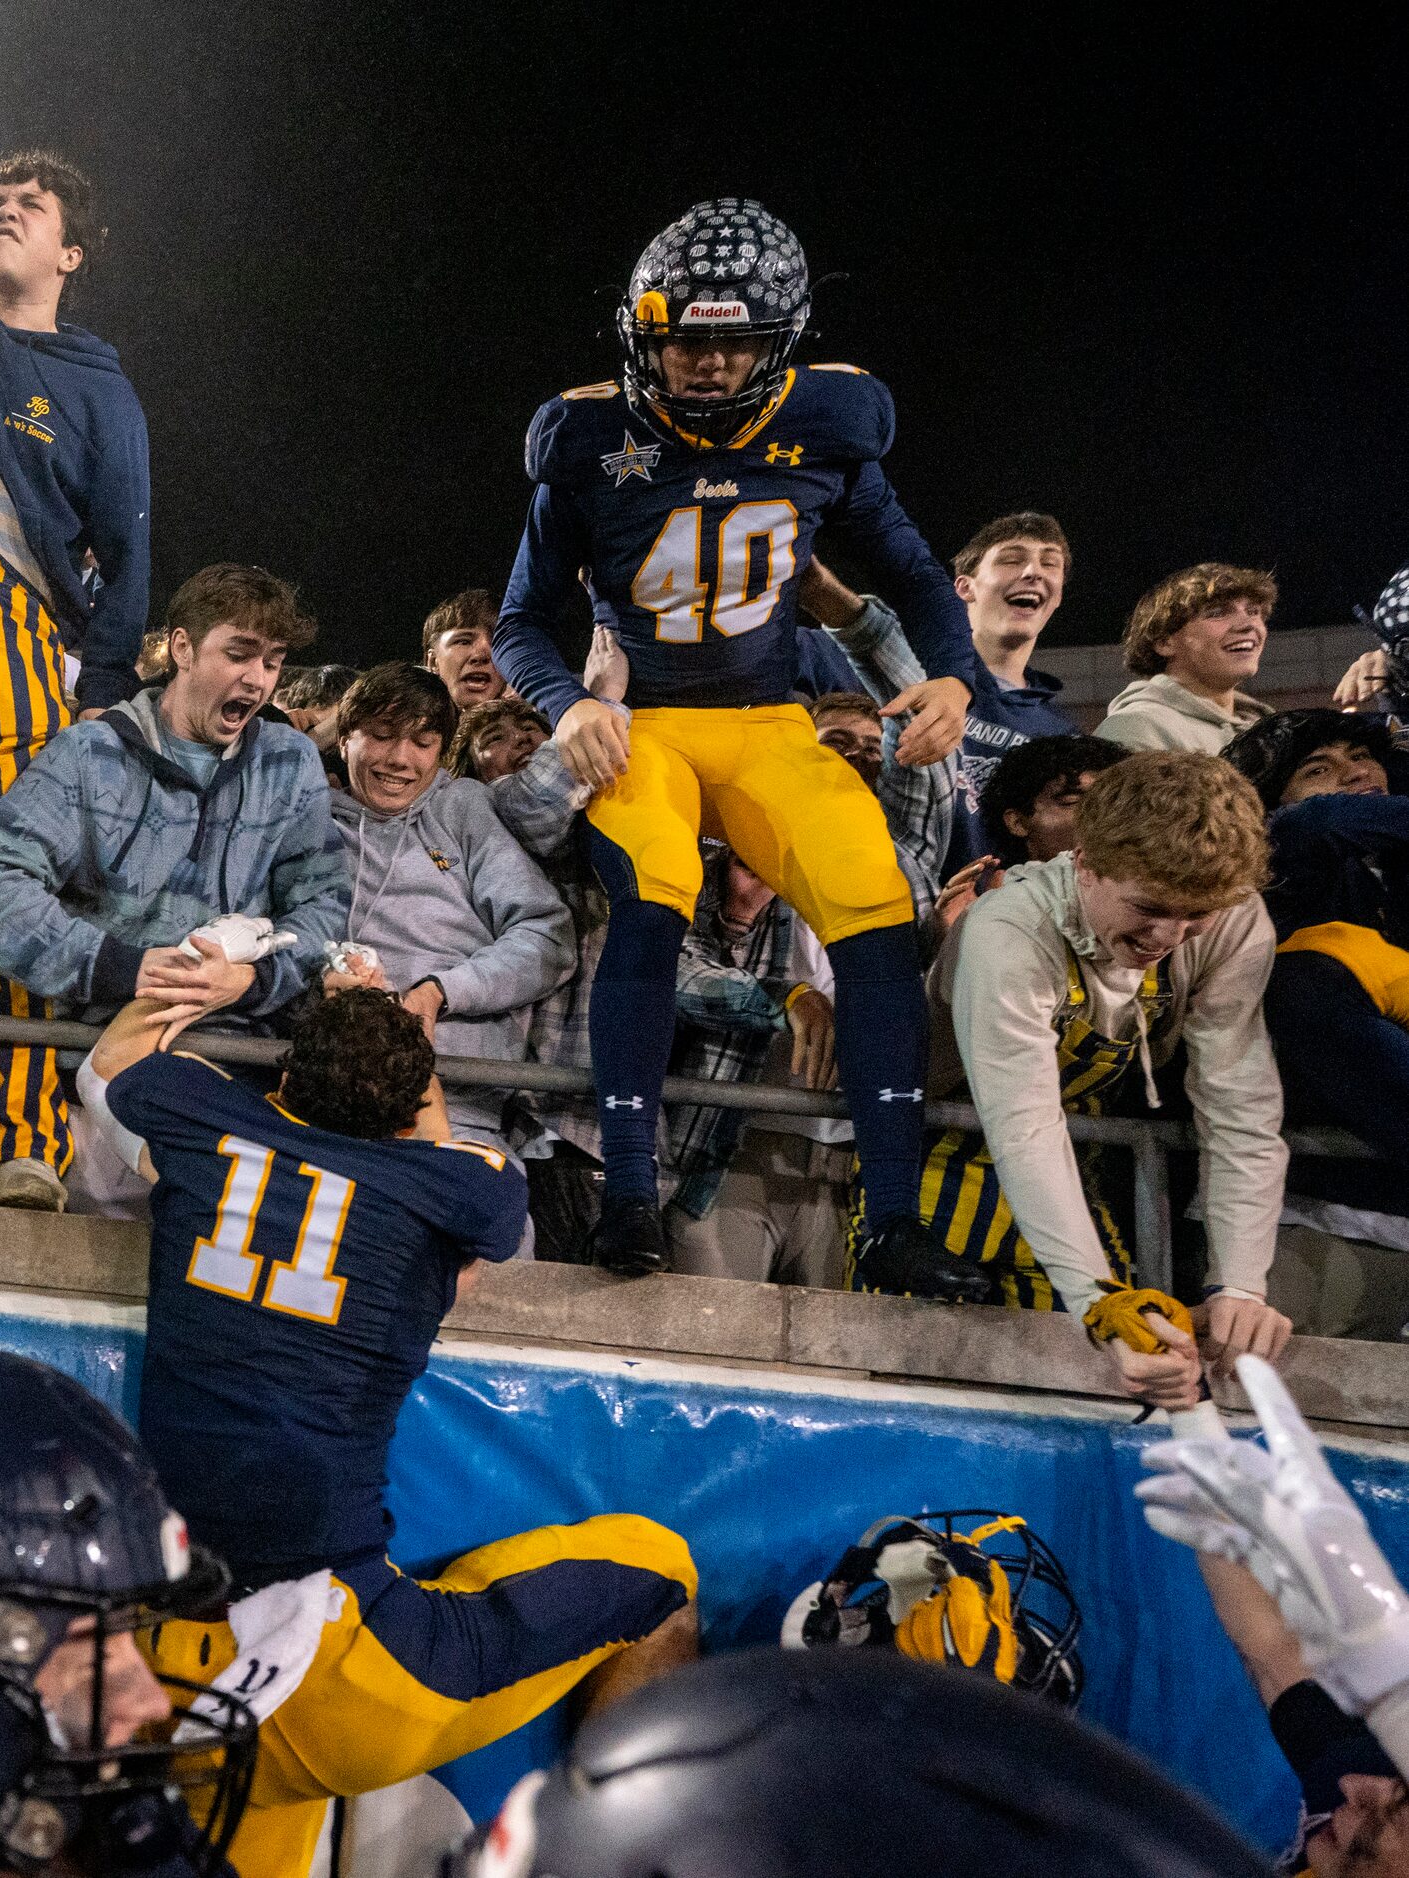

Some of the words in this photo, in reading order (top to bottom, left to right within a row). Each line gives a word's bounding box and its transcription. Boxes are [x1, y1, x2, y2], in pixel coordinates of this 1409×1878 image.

[690, 305, 742, 317] Riddell
[26, 424, 54, 444] Soccer
[693, 478, 739, 499] Scots
[631, 499, 799, 644] 40
[185, 1133, 357, 1326] 11
[234, 1659, 278, 1693] 11
